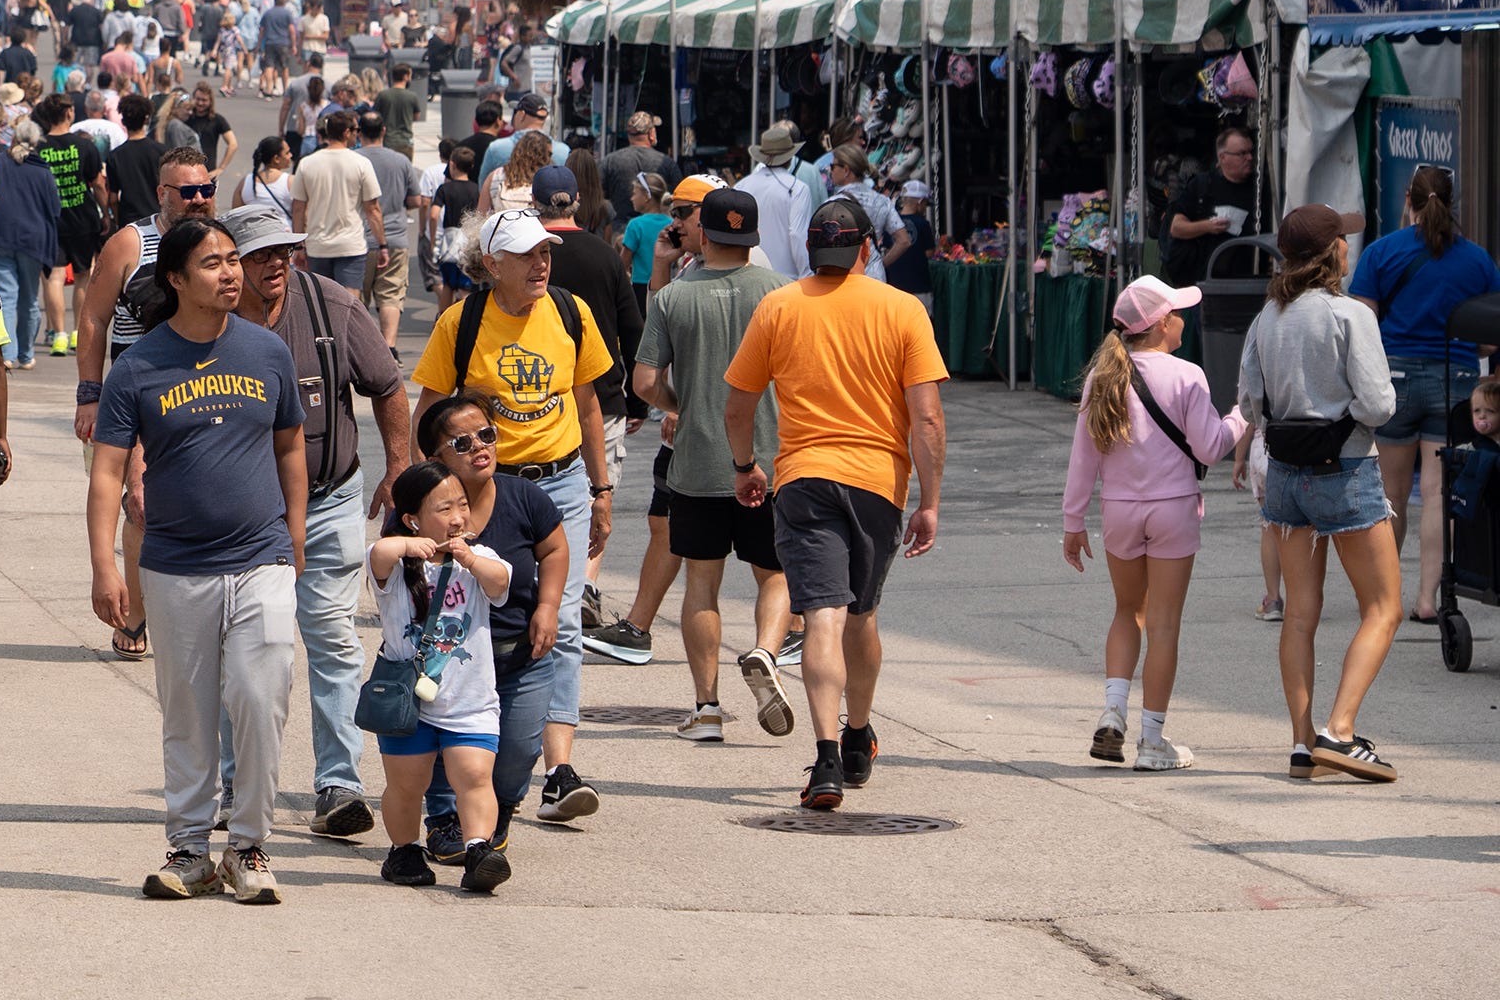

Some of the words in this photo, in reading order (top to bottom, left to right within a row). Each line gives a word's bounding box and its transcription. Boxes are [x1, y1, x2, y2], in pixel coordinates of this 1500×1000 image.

[1388, 120, 1419, 159] GREEK
[1421, 123, 1453, 162] GYROS
[515, 358, 542, 391] M
[159, 374, 268, 416] MILWAUKEE
[191, 401, 244, 414] BASEBALL
